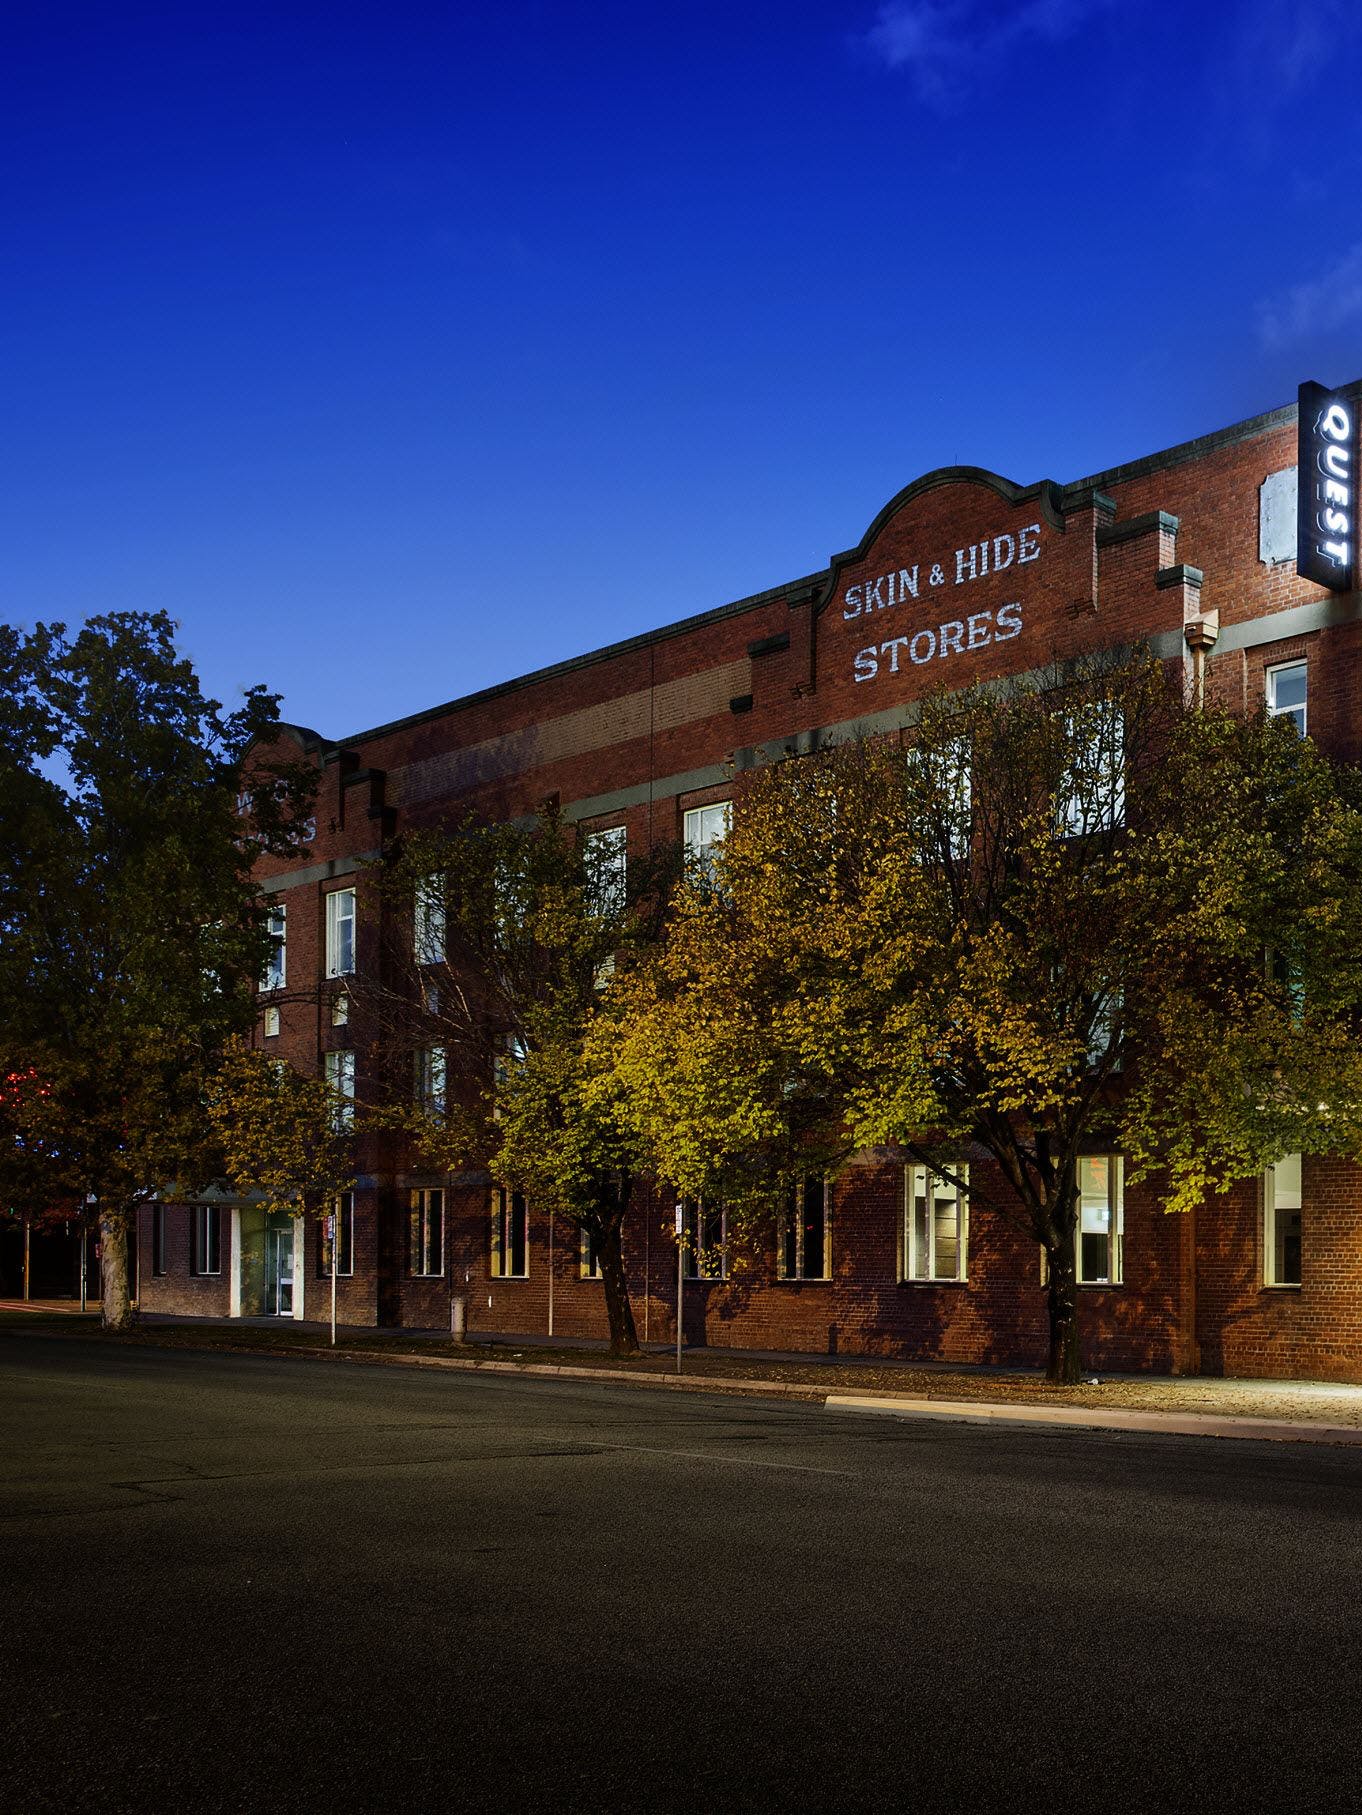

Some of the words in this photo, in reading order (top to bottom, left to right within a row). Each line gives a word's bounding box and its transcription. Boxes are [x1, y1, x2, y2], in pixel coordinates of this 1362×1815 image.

[1322, 404, 1350, 566] QUEST
[843, 564, 920, 620] SKIN
[929, 563, 945, 586] &
[954, 523, 1041, 585] HIDE
[853, 602, 1023, 682] STORES
